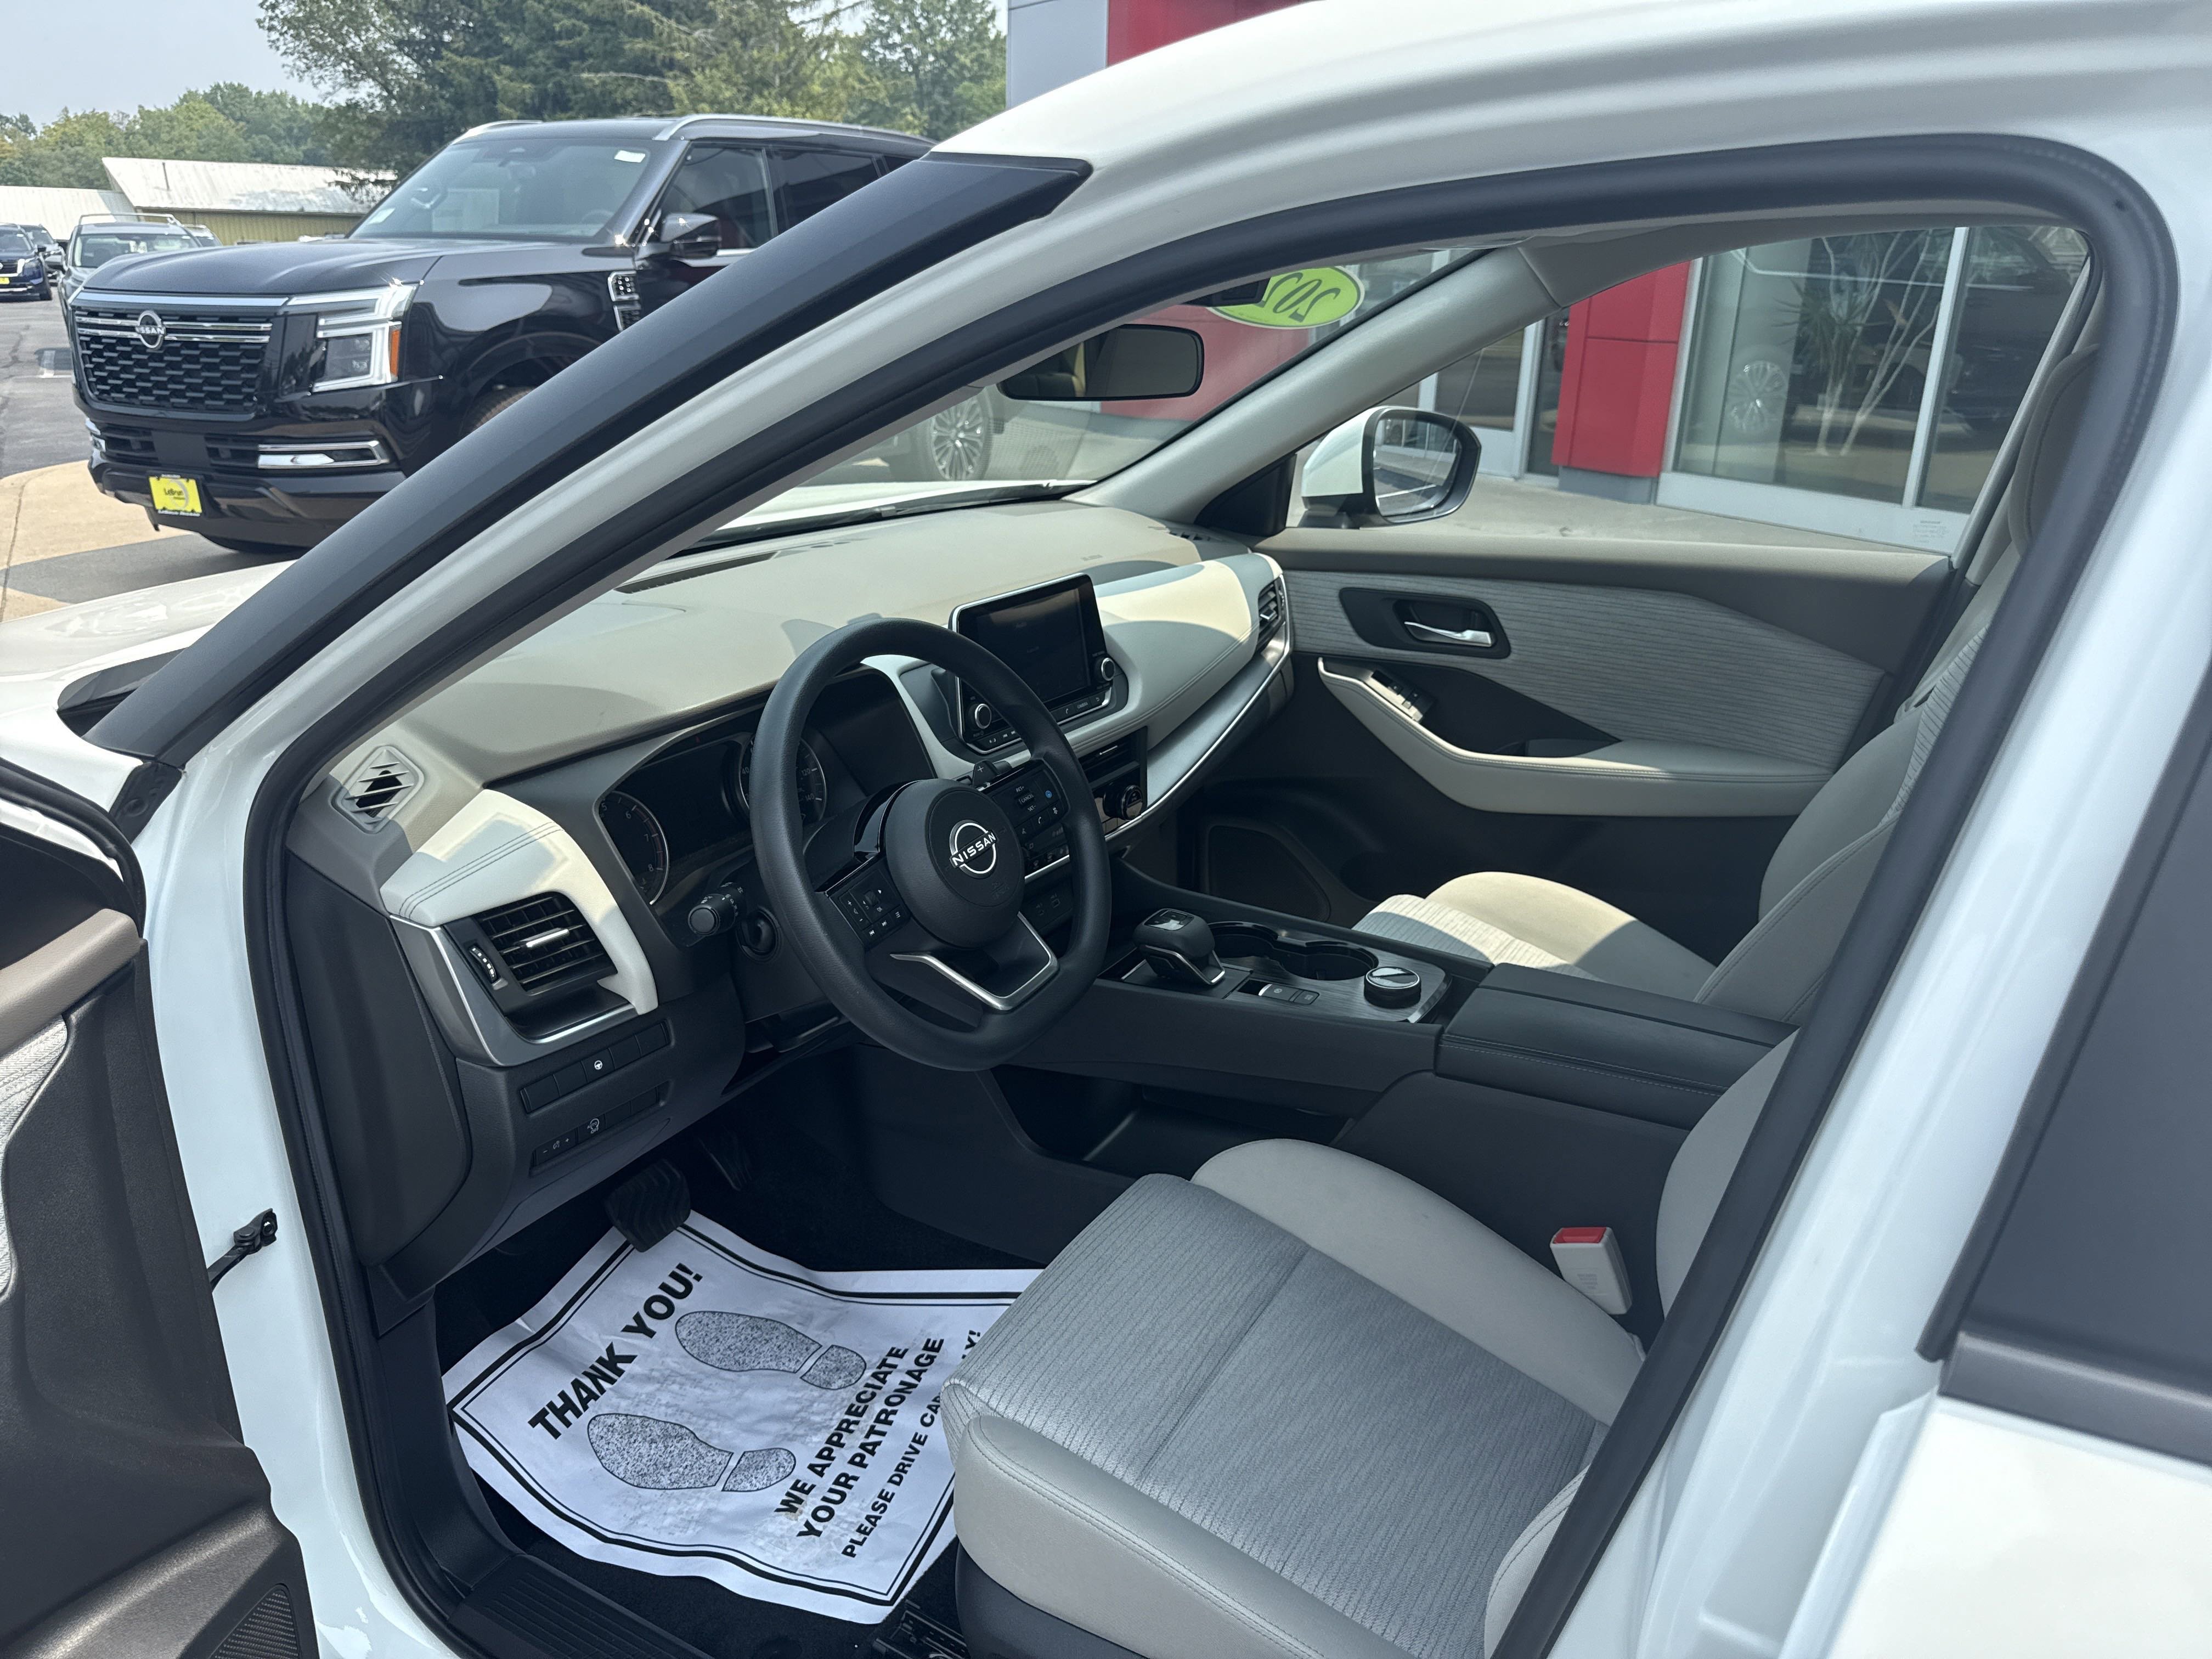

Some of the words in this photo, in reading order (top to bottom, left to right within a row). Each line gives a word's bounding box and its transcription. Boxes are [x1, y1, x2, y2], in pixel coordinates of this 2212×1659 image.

[601, 803, 607, 811] 5
[644, 833, 649, 842] 7
[648, 864, 654, 872] 8
[952, 832, 996, 866] NISSAN
[527, 1341, 638, 1440] THANK
[620, 1262, 703, 1339] YOU!
[774, 1479, 817, 1514] WE
[807, 1346, 909, 1478] APPRECIATE
[796, 1472, 860, 1537] YOUR
[847, 1338, 945, 1469] PATRONAGE
[841, 1488, 895, 1558] PLEASE
[887, 1432, 928, 1487] DRIVE
